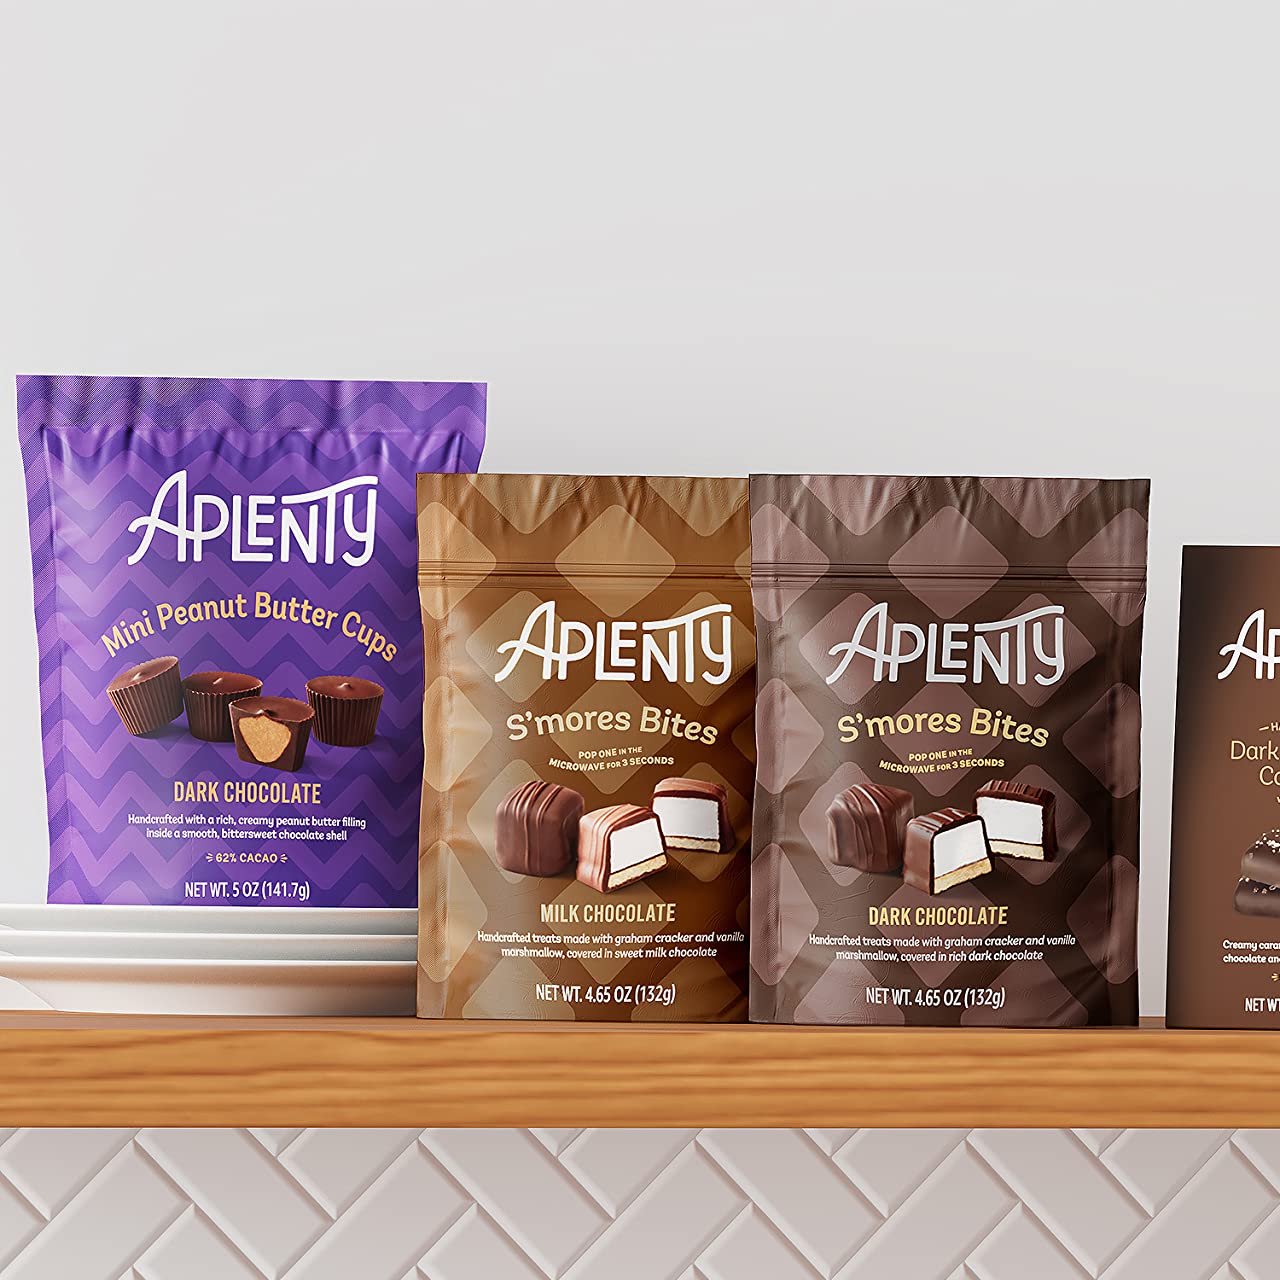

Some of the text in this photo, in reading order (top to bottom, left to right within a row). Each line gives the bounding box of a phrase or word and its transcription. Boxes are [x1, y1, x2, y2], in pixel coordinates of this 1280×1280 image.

[127, 469, 378, 567] APLENTY
[101, 592, 396, 661] Mini Peanut Butter Cups
[495, 601, 731, 684] APLENTY
[826, 601, 1064, 687] APLENTY
[641, 707, 718, 745] Bites
[970, 708, 1048, 747] Bites
[579, 751, 598, 759] POP
[599, 748, 617, 758] ONE
[1231, 741, 1279, 760] Dark
[175, 782, 321, 803] DARK CHOCOLATE
[216, 853, 277, 863] 62% CACAO
[184, 881, 309, 901] NET WT. 5 OZ (141.7g)
[540, 904, 676, 922] MILK CHOCOLATE
[870, 906, 1008, 926] DARK CHOCOLATE
[867, 986, 1005, 1009] NET WT. 4.65 OZ (132g)
